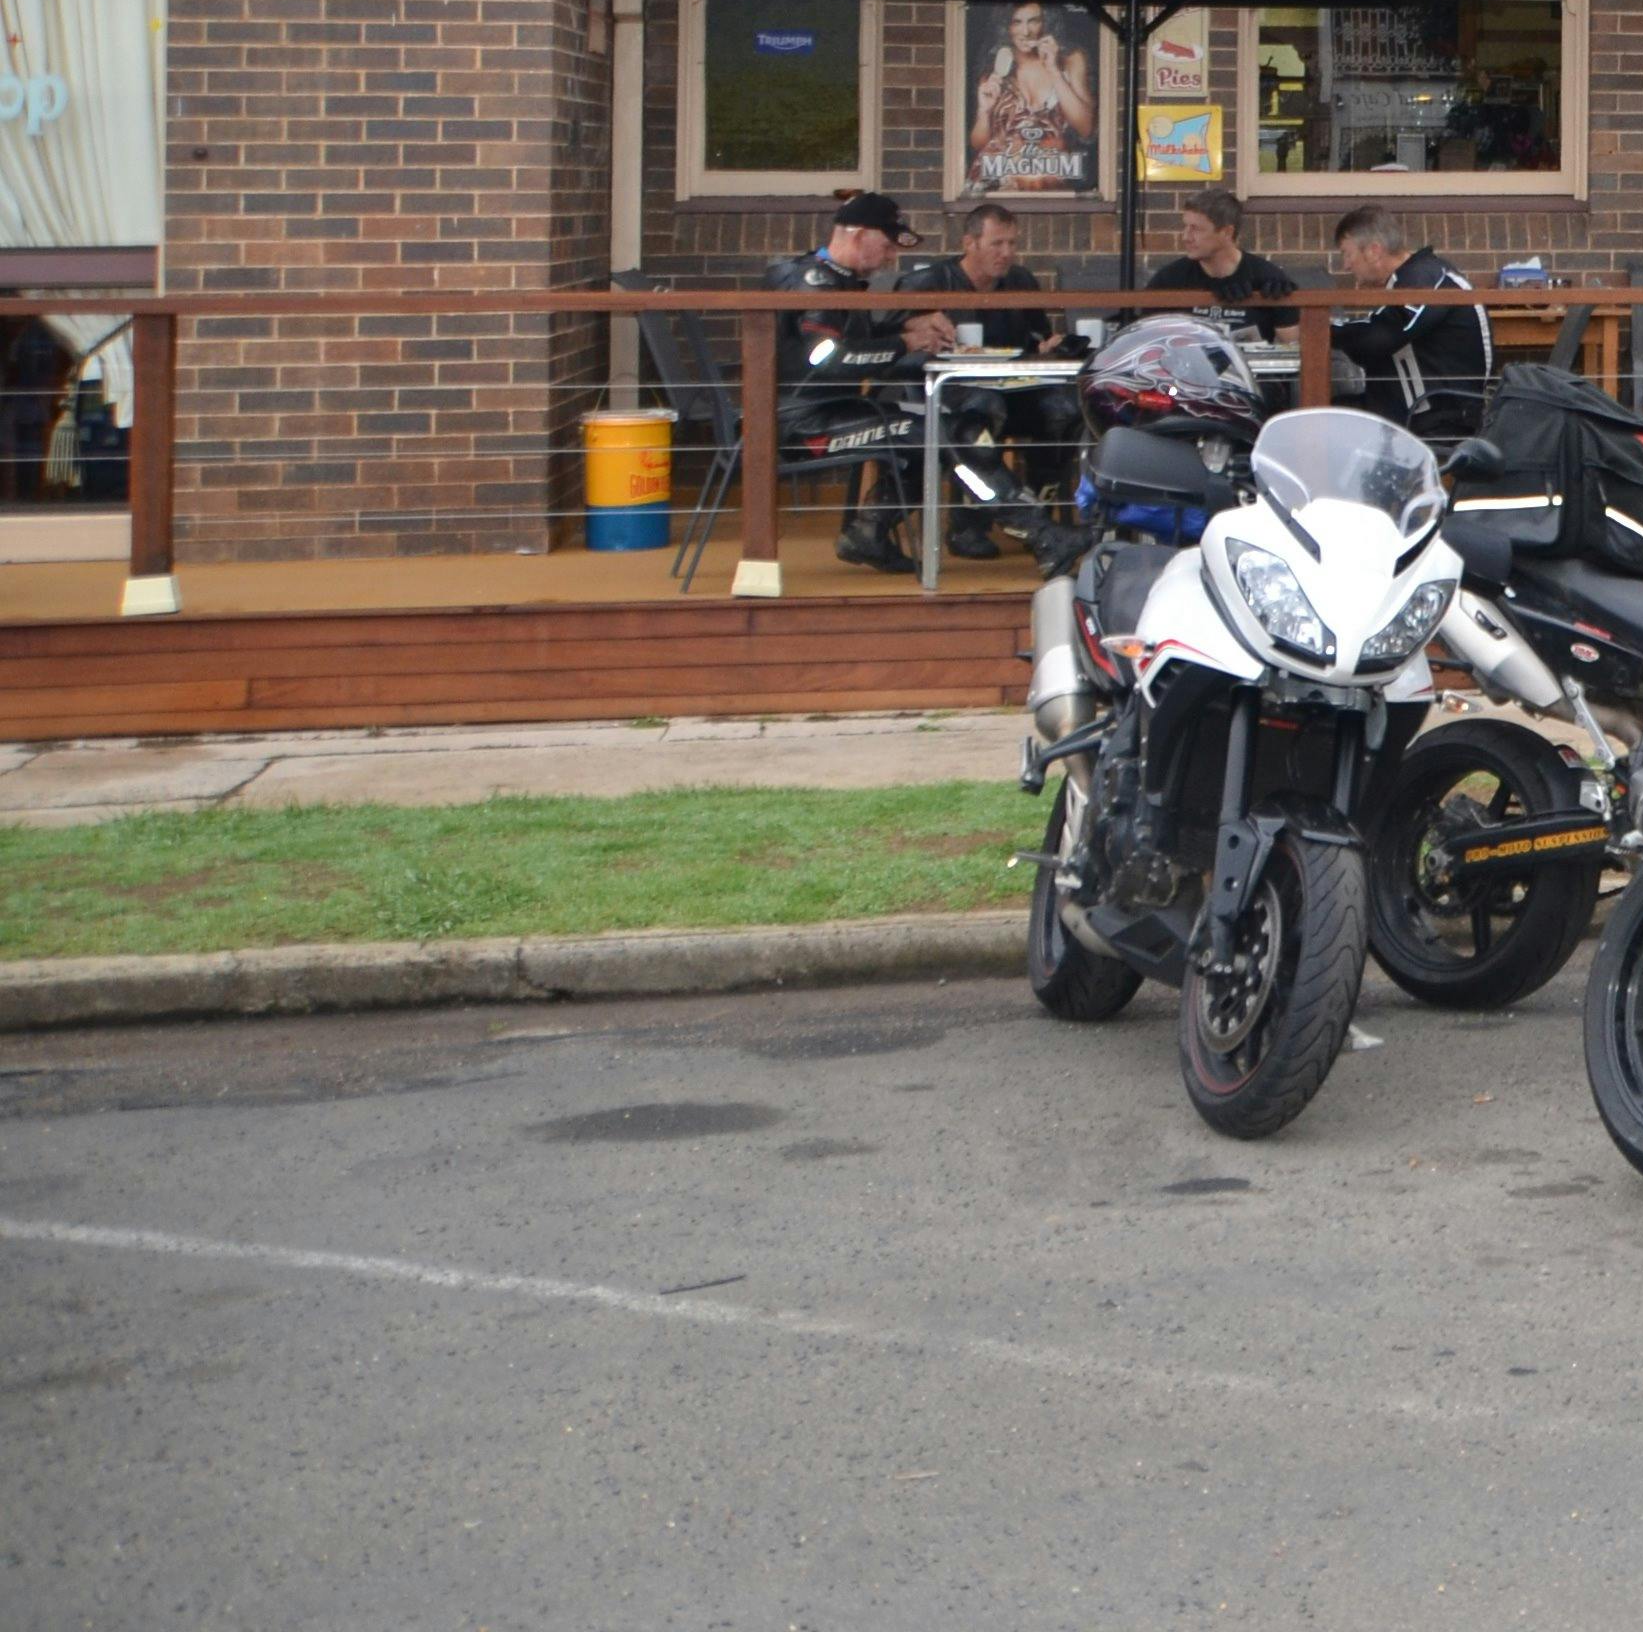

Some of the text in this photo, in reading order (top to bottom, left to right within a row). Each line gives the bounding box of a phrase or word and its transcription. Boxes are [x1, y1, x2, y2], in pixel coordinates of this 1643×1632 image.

[756, 33, 813, 47] TRIUMPH
[1156, 68, 1202, 90] Pies
[0, 73, 70, 136] op
[982, 153, 1083, 178] MAGNUM
